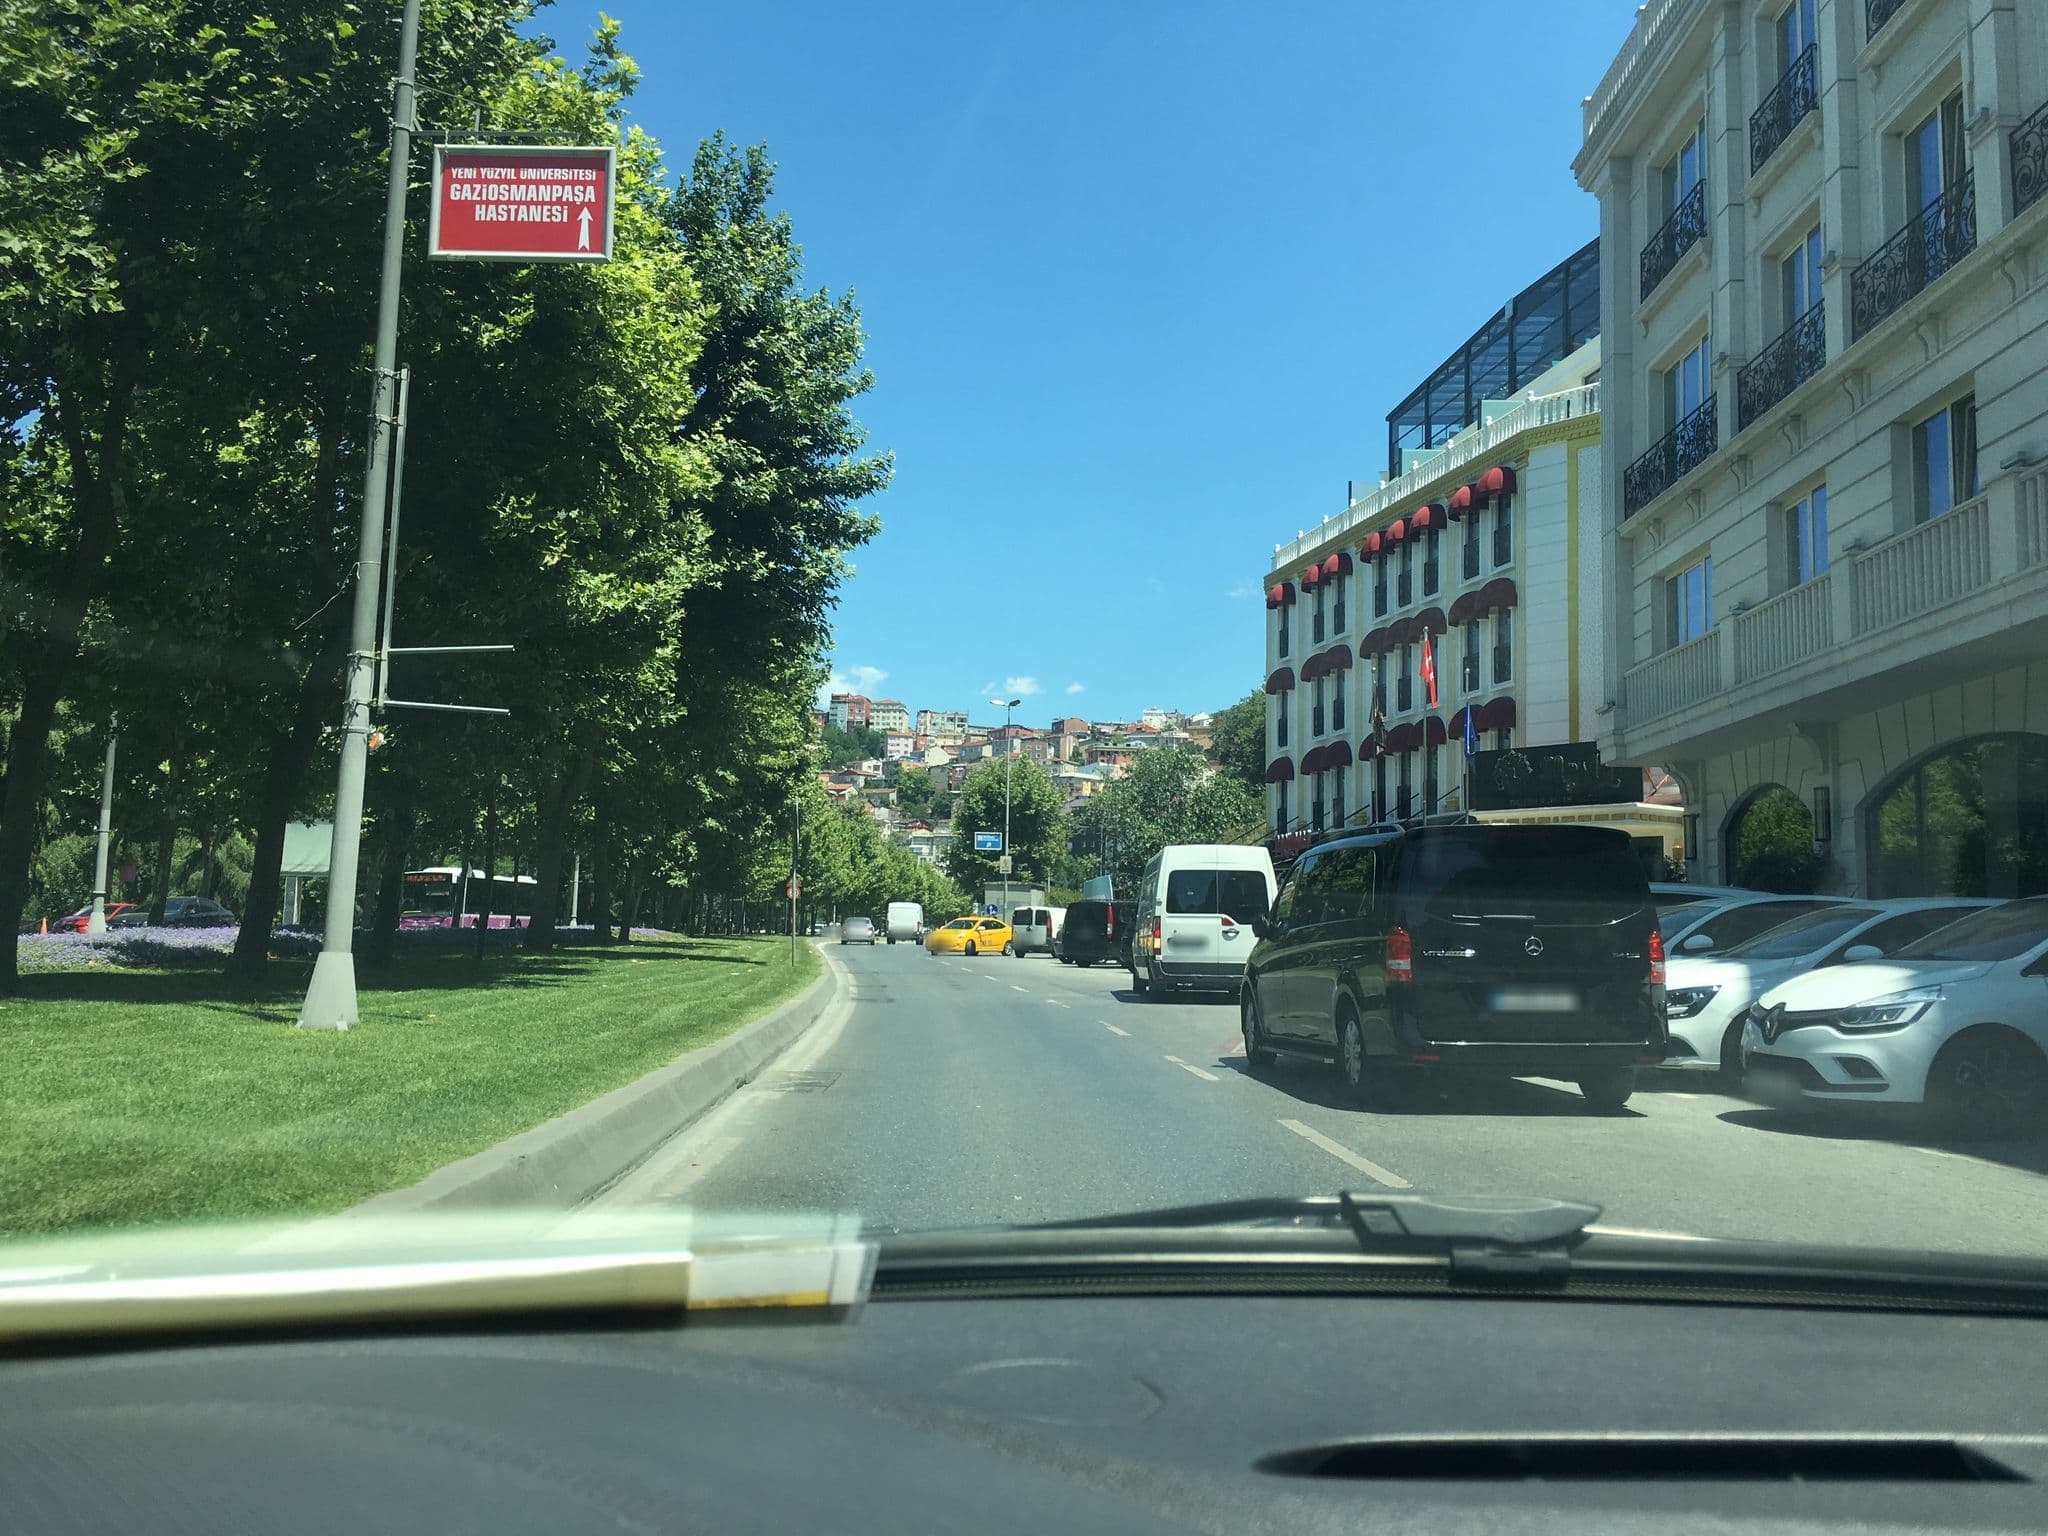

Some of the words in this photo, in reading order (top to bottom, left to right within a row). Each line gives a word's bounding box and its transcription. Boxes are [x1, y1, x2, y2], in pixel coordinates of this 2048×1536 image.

[451, 167, 477, 179] YENİ
[480, 168, 517, 180] YÜZYIL
[520, 168, 596, 181] ÜNİVERSİTESİ
[450, 183, 596, 205] GAZİOSMANPAŞA
[474, 204, 568, 223] HASTANESİ
